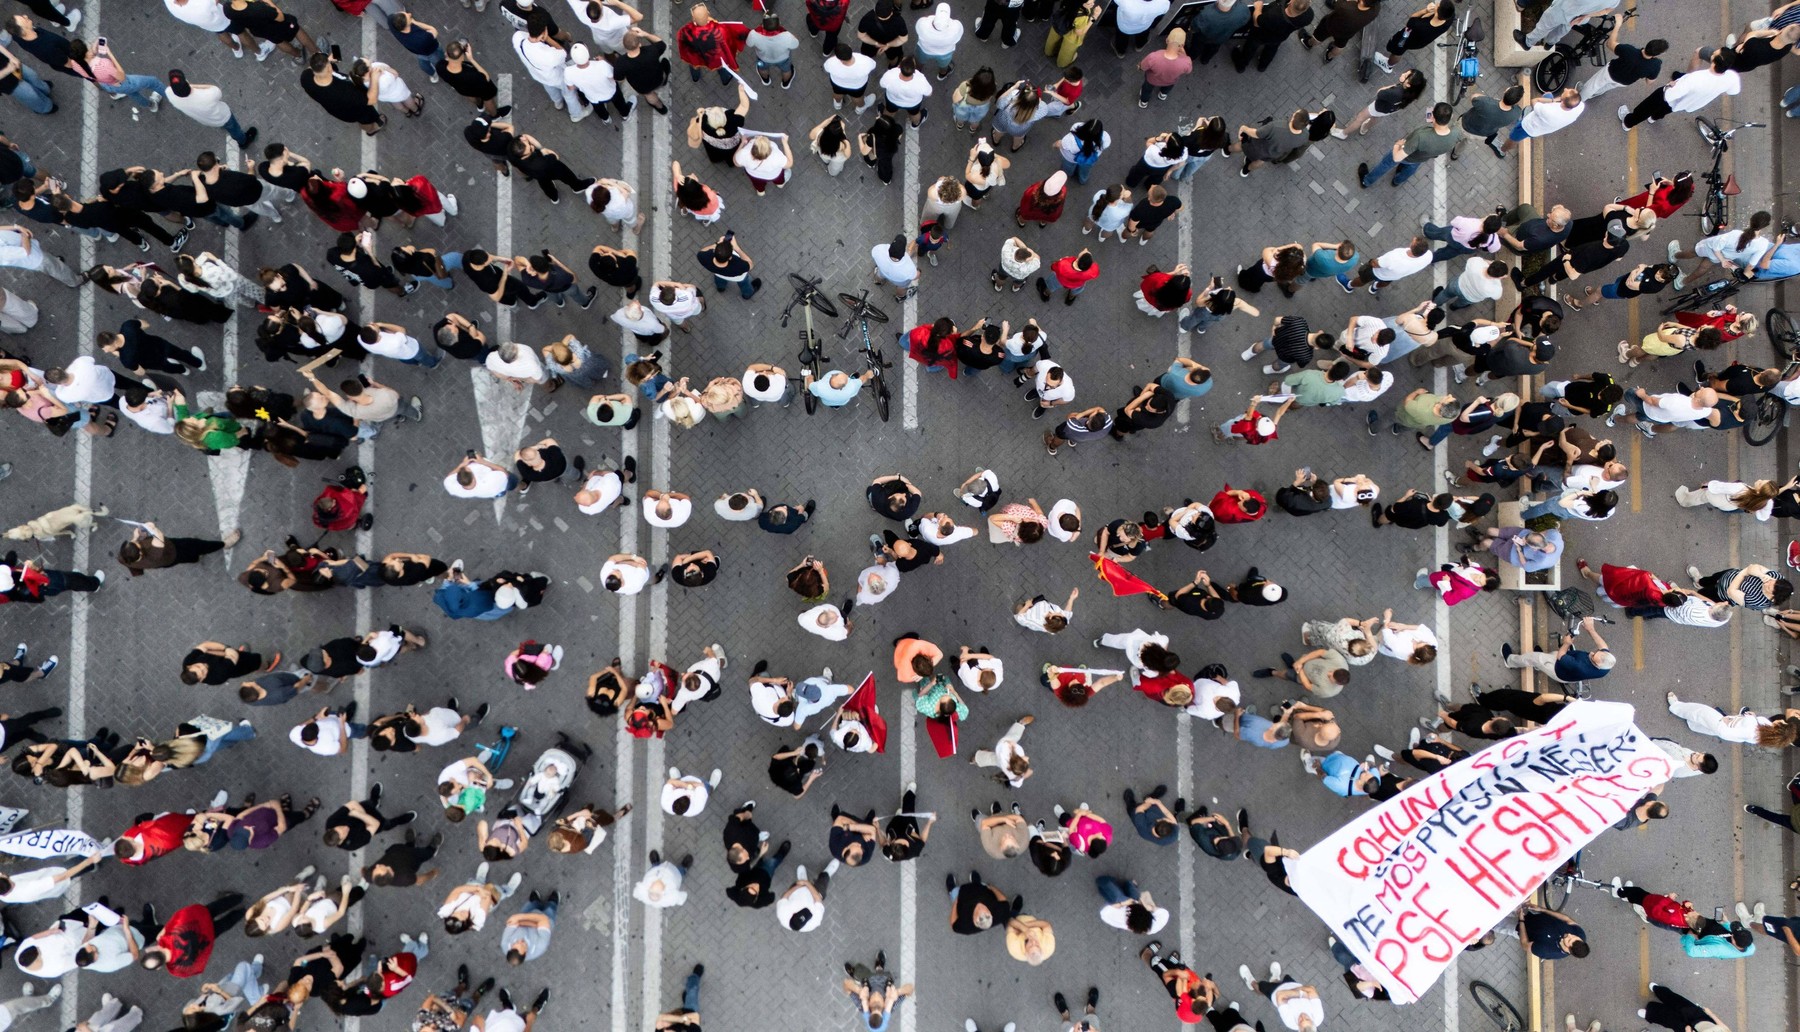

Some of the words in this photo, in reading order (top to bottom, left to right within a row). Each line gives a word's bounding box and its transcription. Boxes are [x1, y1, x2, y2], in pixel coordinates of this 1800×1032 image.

[1343, 904, 1385, 953] TE
[1375, 844, 1427, 914] MOS
[1375, 882, 1481, 1000] PSE
